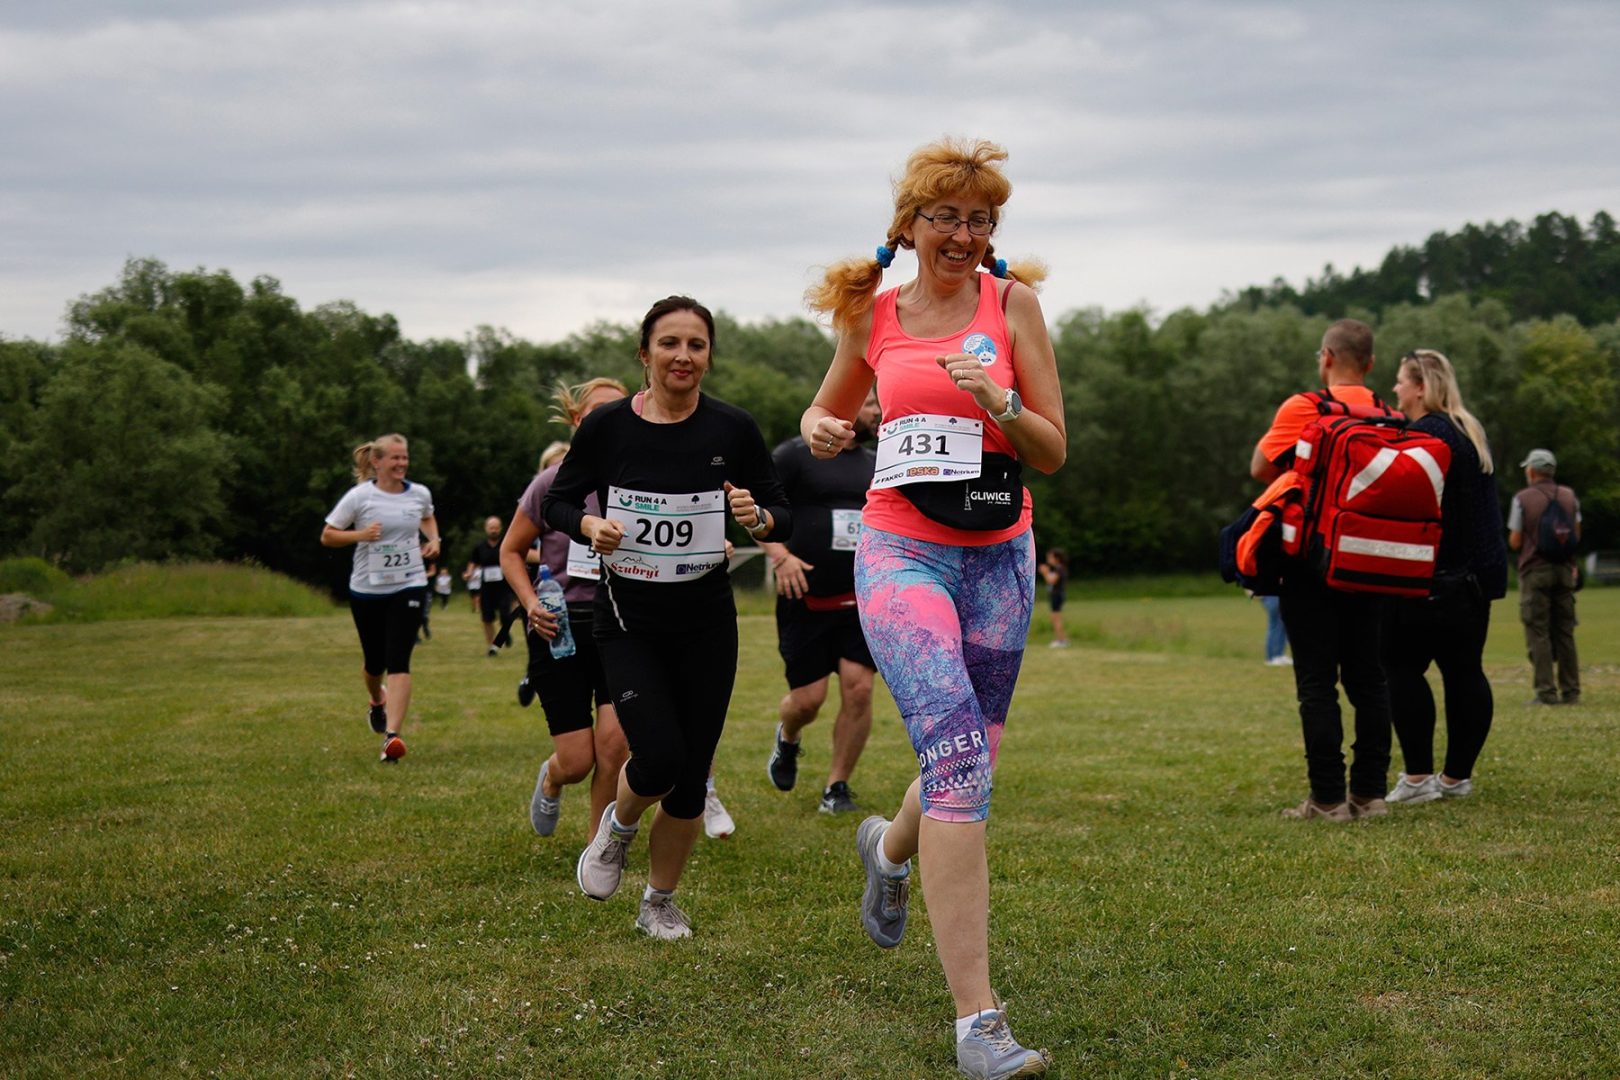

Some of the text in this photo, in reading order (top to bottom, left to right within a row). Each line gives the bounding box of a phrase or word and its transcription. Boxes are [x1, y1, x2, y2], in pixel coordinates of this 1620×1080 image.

[898, 433, 950, 456] 431
[881, 472, 904, 483] FAKRO
[634, 495, 652, 504] RUN
[970, 491, 1011, 501] GLIWICE
[634, 502, 660, 511] SMILE
[635, 518, 694, 547] 209
[383, 552, 411, 568] 223
[610, 561, 660, 579] Szubryt
